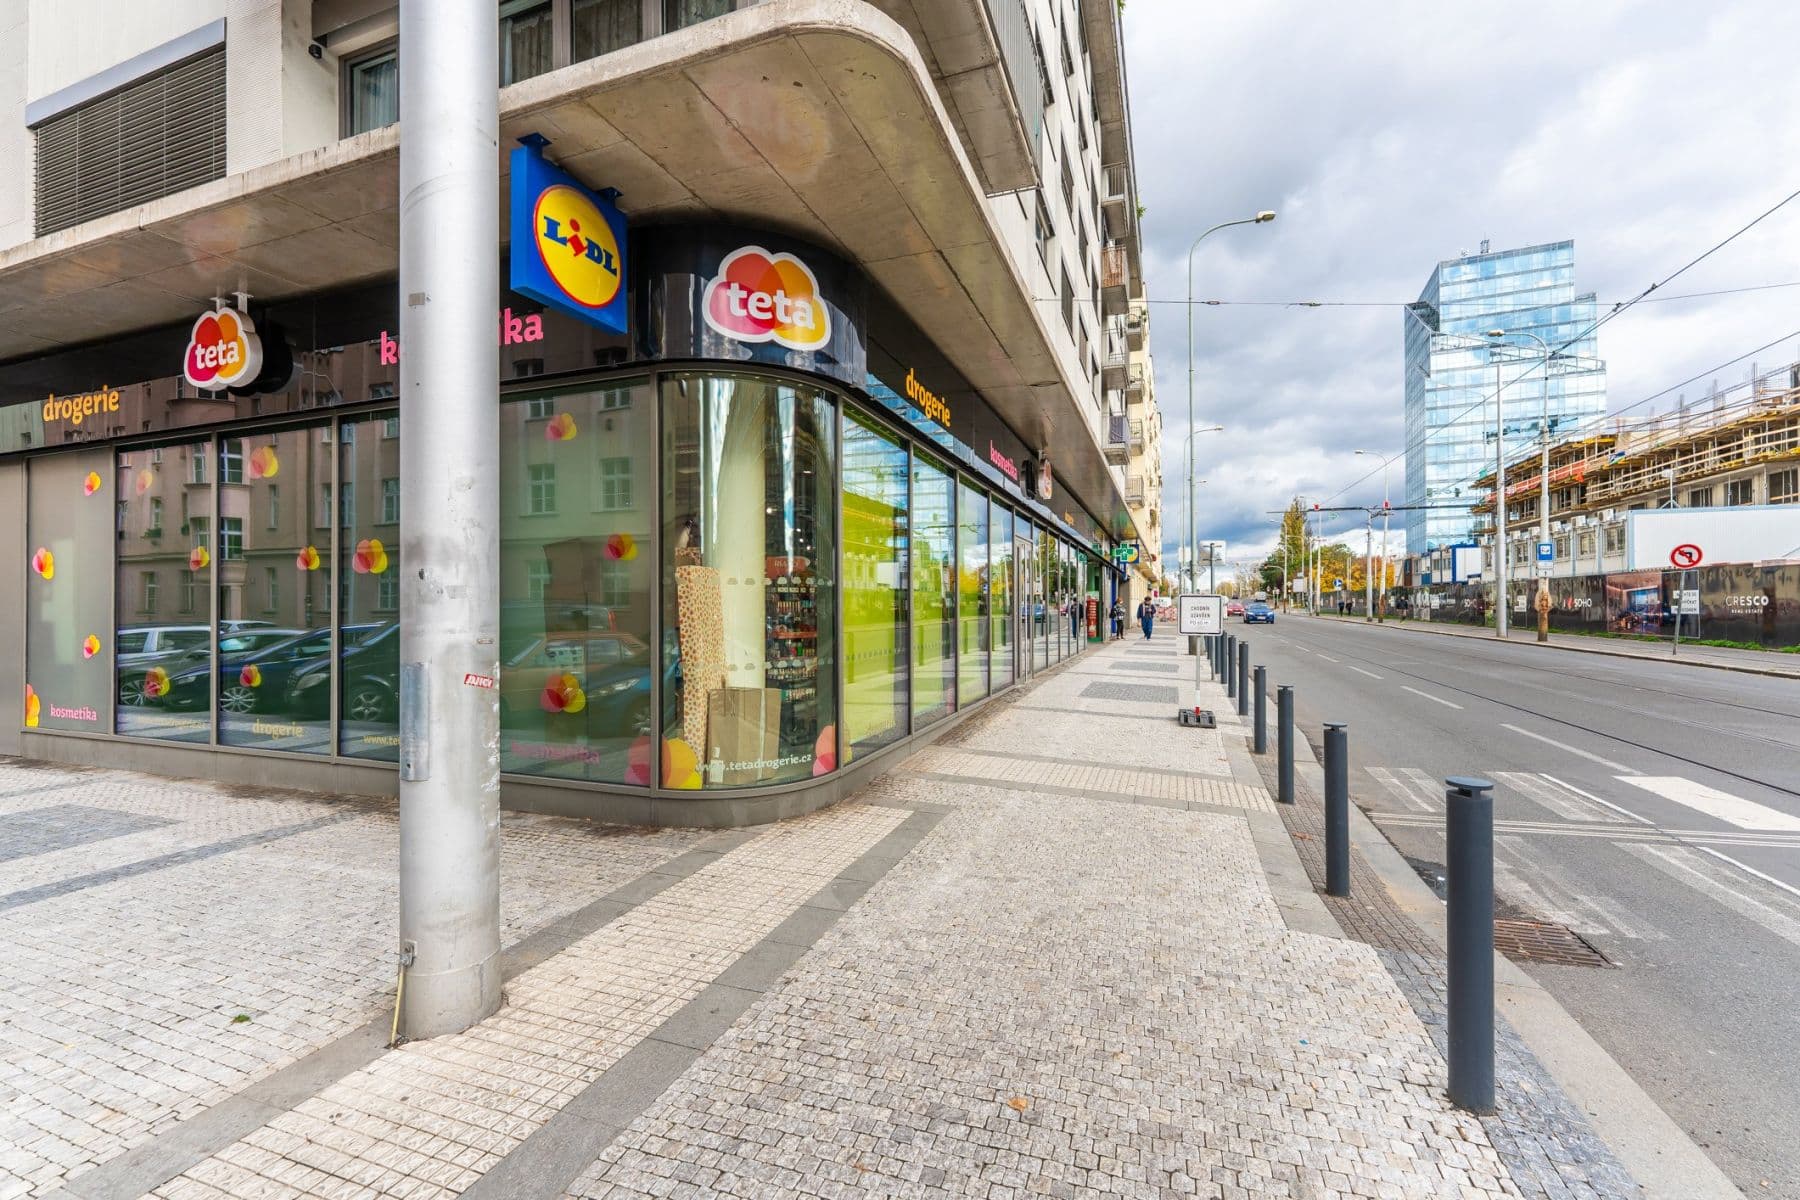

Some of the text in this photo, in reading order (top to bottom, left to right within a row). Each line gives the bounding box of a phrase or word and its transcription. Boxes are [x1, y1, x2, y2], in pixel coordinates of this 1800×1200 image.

[727, 282, 815, 330] teta
[195, 339, 240, 369] teta
[43, 385, 120, 425] drogerie
[905, 368, 951, 427] drogerie
[990, 439, 1018, 480] kosmetika
[1574, 598, 1592, 608] SOHO
[1725, 595, 1769, 606] CRESCO
[50, 703, 97, 721] kosmetika
[252, 719, 304, 740] drogerie
